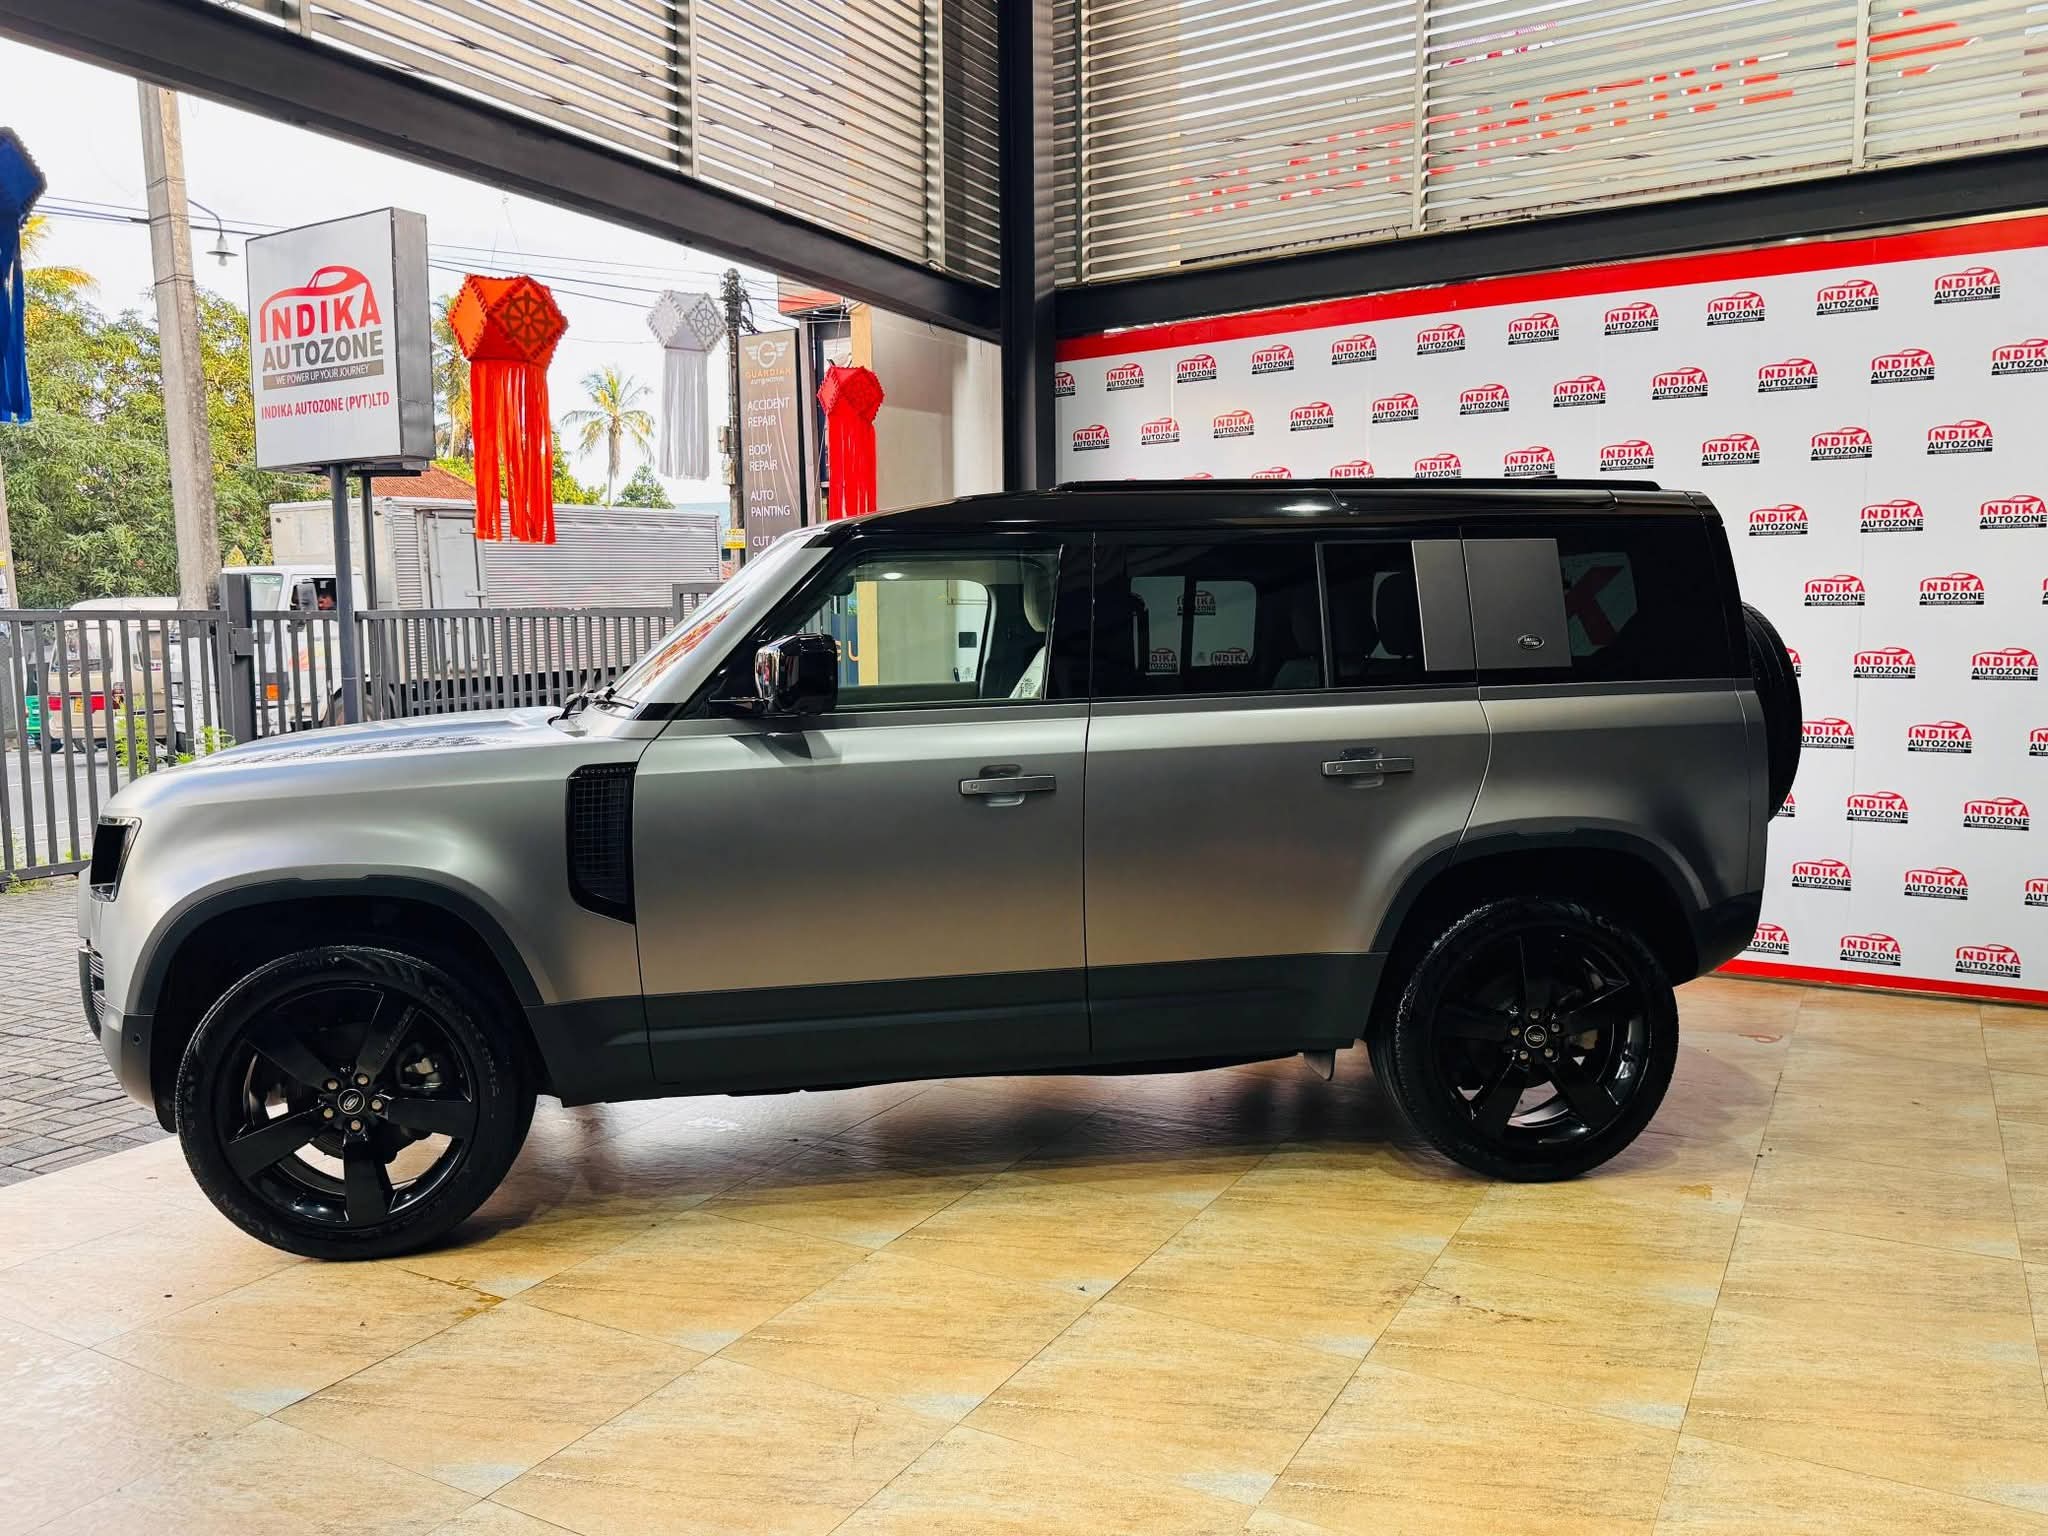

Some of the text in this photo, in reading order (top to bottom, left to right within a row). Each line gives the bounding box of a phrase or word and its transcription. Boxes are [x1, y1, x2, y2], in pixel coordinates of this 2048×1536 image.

[1935, 270, 2000, 290] INDIKA
[1817, 283, 1878, 302] INDIKA
[1935, 286, 2000, 299] AUTOZONE
[1708, 295, 1764, 312] INDIKA
[1817, 298, 1878, 310] AUTOZONE
[260, 280, 381, 343] INDIKA
[1604, 306, 1658, 322] INDIKA
[1708, 309, 1764, 321] AUTOZONE
[1509, 316, 1559, 332] INDIKA
[1604, 319, 1658, 330] AUTOZONE
[1417, 327, 1464, 342] INDIKA
[1509, 329, 1559, 340] AUTOZONE
[263, 330, 384, 372] AUTOZONE
[1333, 338, 1375, 352] INDIKA
[1417, 339, 1464, 351] AUTOZONE
[1992, 342, 2048, 360] INDIK
[1252, 348, 1293, 362] INDIKA
[1333, 350, 1375, 360] AUTOZONE
[1871, 352, 1934, 370] INDIKA
[1181, 357, 1216, 372] INDIKA
[1252, 360, 1293, 370] AUTOZONE
[1759, 361, 1817, 378] INDIKA
[275, 364, 369, 385] WE POWER UP YOUR JOURNEY
[1108, 366, 1143, 380] INDIKA
[1181, 369, 1216, 378] AUTOZONE
[1653, 371, 1707, 386] INDIKA
[1871, 368, 1934, 379] AUTOZONE
[1108, 378, 1143, 387] AUTOZONE
[1554, 378, 1605, 394] INDIKA
[1759, 376, 1817, 387] AUTOZONE
[1460, 387, 1509, 402] INDIKA
[1653, 385, 1707, 395] AUTOZONE
[747, 396, 790, 411] ACCIDENT
[1373, 397, 1418, 412] INDIKA
[1554, 393, 1605, 403] AUTOZONE
[261, 403, 293, 420] INDIKA
[295, 398, 344, 416] AUTOZONE
[1291, 405, 1333, 420] INDIKA
[1460, 401, 1509, 410] AUTOZONE
[748, 412, 776, 428] REPAIR
[1214, 413, 1254, 426] INDIKA
[1373, 409, 1418, 418] AUTOZONE
[1143, 420, 1178, 434] INDIKA
[1291, 417, 1333, 426] AUTOZONE
[1074, 427, 1109, 438] INDIKA
[1214, 426, 1254, 434] AUTOZONE
[1928, 423, 1992, 440] INDIKA
[1074, 439, 1109, 447] AUTOZONE
[1702, 437, 1759, 452] INDIKA
[1812, 430, 1871, 448] INDIKA
[1928, 439, 1992, 449] AUTOZONE
[749, 443, 773, 456] BODY
[1600, 443, 1654, 458] INDIKA
[1702, 452, 1759, 461] AUTOZONE
[1812, 446, 1871, 455] AUTOZONE
[1415, 456, 1461, 471] INDIKA
[1504, 450, 1555, 464] INDIKA
[1600, 458, 1654, 466] AUTOZONE
[749, 457, 778, 472] REPAIR
[1504, 463, 1555, 472] AUTOZONE
[1415, 469, 1461, 479] AUTOZONE
[750, 488, 775, 502] AUTO
[751, 503, 791, 517] PAINTING
[1861, 503, 1923, 520] INDIKA
[1980, 499, 2047, 516] INDIKA
[1749, 507, 1807, 524] INDIKA
[1980, 515, 2047, 524] AUTOZONE
[1749, 523, 1807, 531] AUTOZONE
[1861, 519, 1923, 527] AUTOZONE
[752, 535, 769, 547] CUT
[1805, 578, 1865, 594] INDIKA
[1920, 576, 1984, 592] INDIKA
[1854, 651, 1915, 666] INDIKA
[1972, 652, 2038, 668] INDIKA
[1802, 721, 1854, 736] NDIKA
[1908, 725, 1971, 740] INDIKA
[1802, 736, 1854, 744] UTOZONE
[1908, 739, 1971, 748] AUTOZONE
[1847, 796, 1908, 810] INDIKA
[1965, 802, 2029, 816] INDIKA
[1847, 809, 1908, 818] AUTOZONE
[1965, 815, 2029, 825] AUTOZONE
[1792, 864, 1850, 878] INDIKA
[1792, 875, 1850, 886] AUTOZONE
[1905, 872, 1967, 886] INDIKA
[1905, 884, 1967, 895] AUTOZONE
[1840, 938, 1900, 952] INDIKA
[1840, 949, 1900, 961] AUTOZONE
[1955, 949, 2020, 964] INDIKA
[1955, 960, 2020, 973] AUTOZONE
